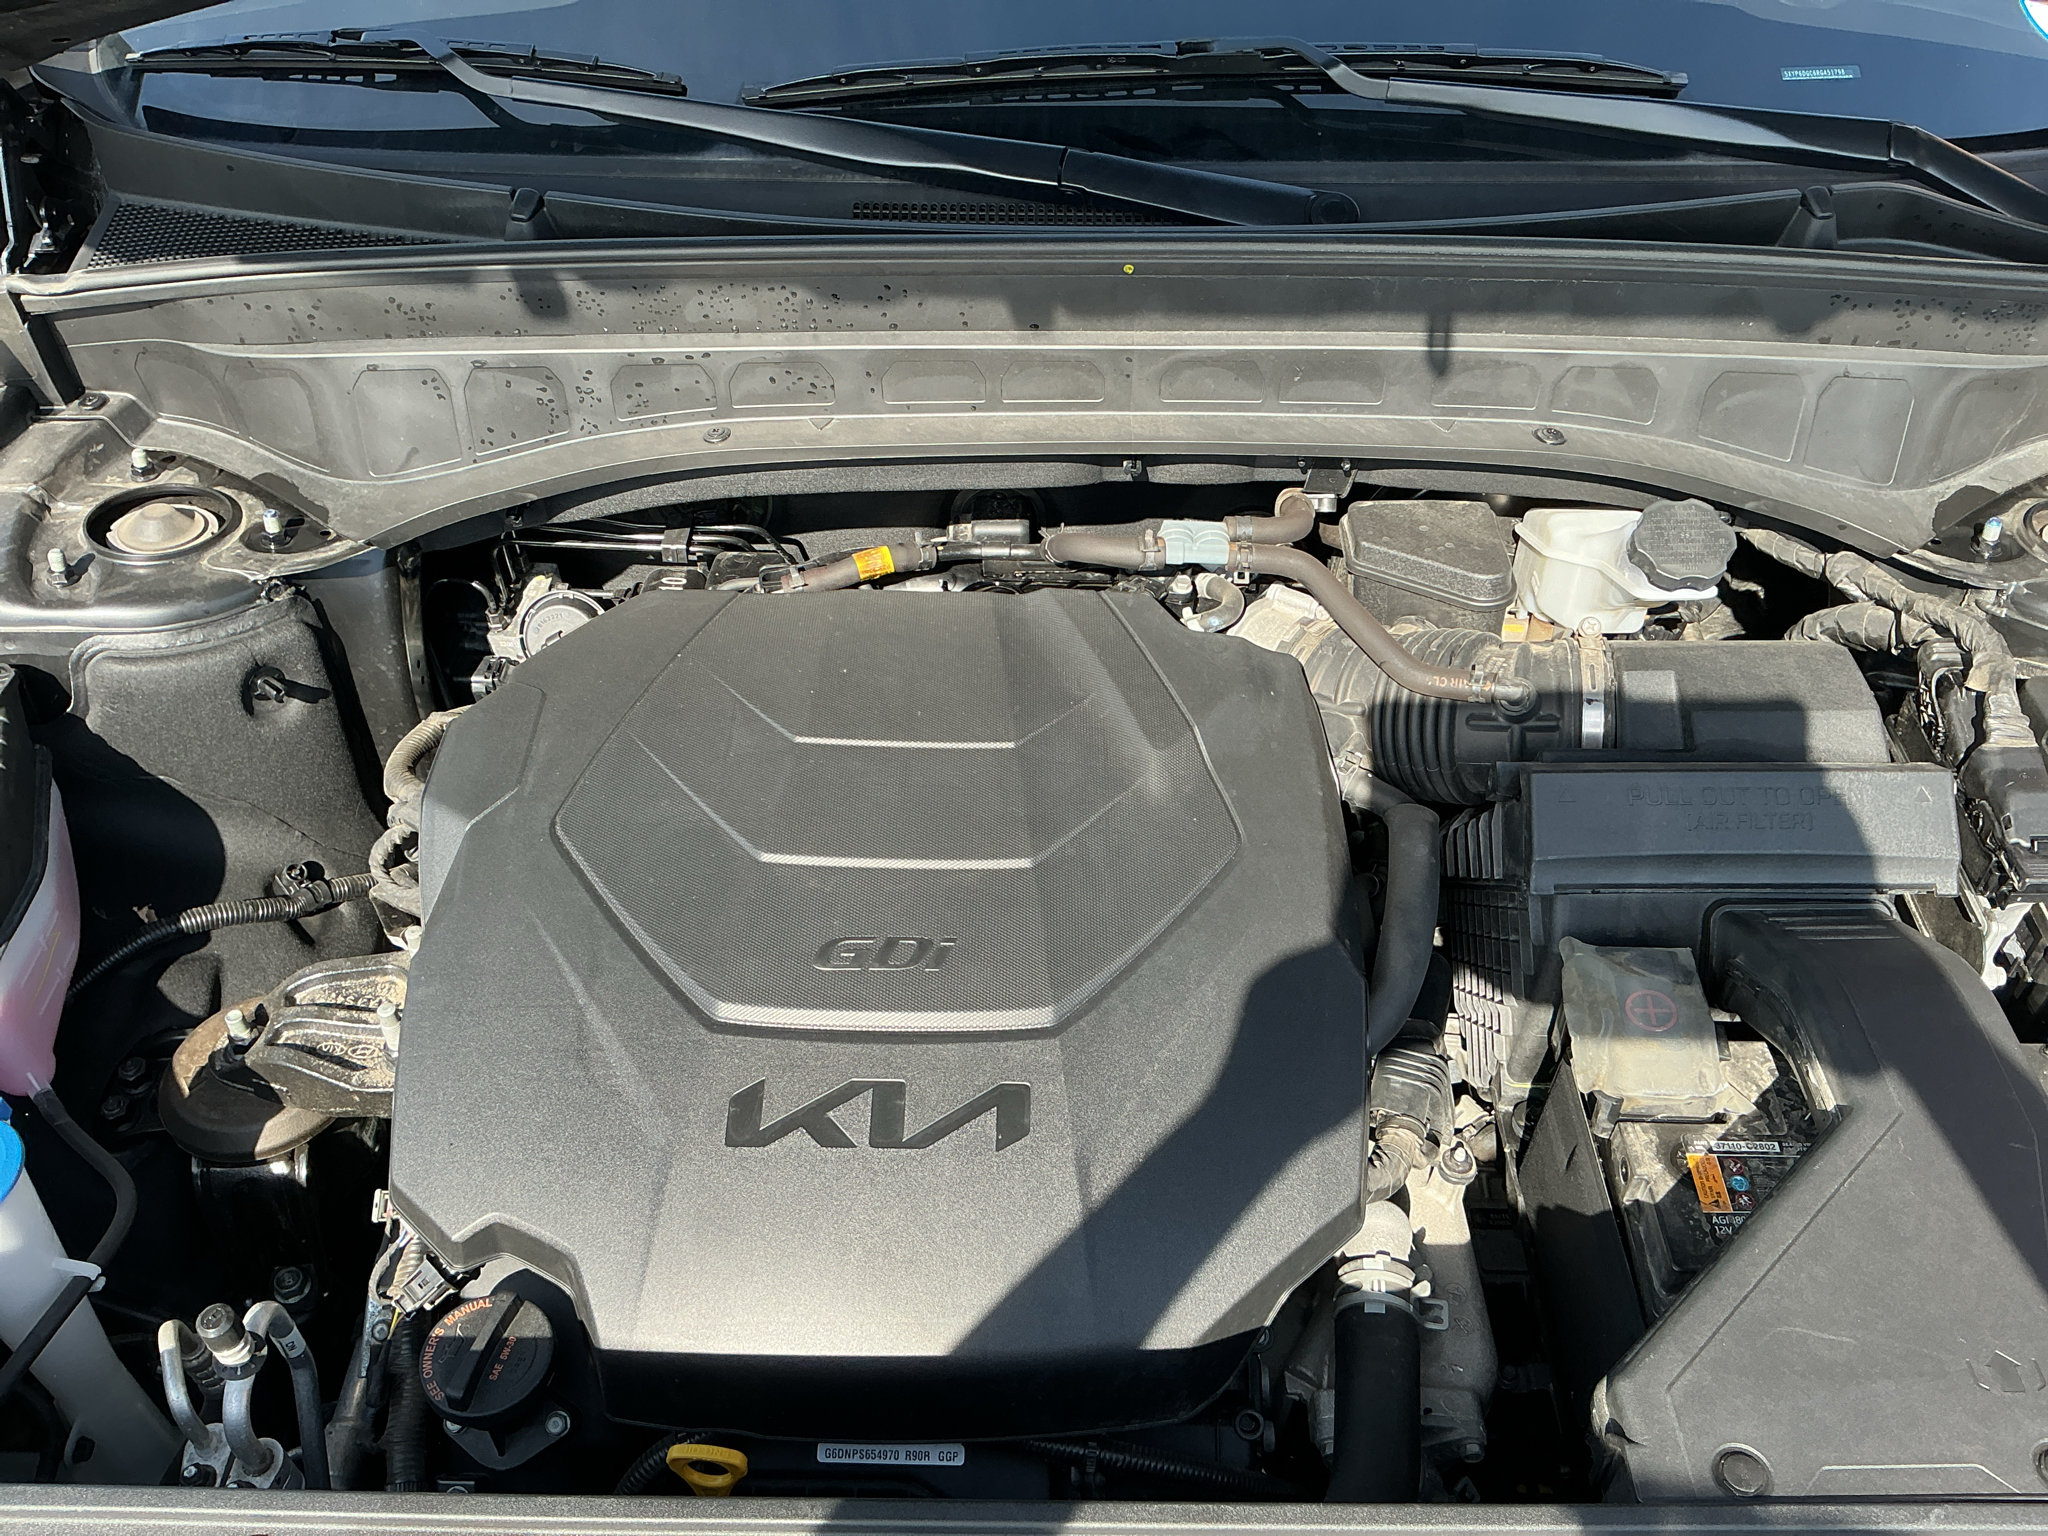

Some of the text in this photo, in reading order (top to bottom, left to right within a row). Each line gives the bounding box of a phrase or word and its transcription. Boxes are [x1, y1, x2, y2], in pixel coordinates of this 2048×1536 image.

[1629, 783, 1860, 806] PULL OUT TO OPE
[724, 1076, 1031, 1152] KIA
[1713, 1141, 1778, 1152] 37110-C2802
[422, 1298, 492, 1401] SEE OWNER'S MANUAL
[488, 1336, 517, 1381] SAE 5W-30
[824, 1447, 960, 1463] G6DNPS654970 R90R GGP
